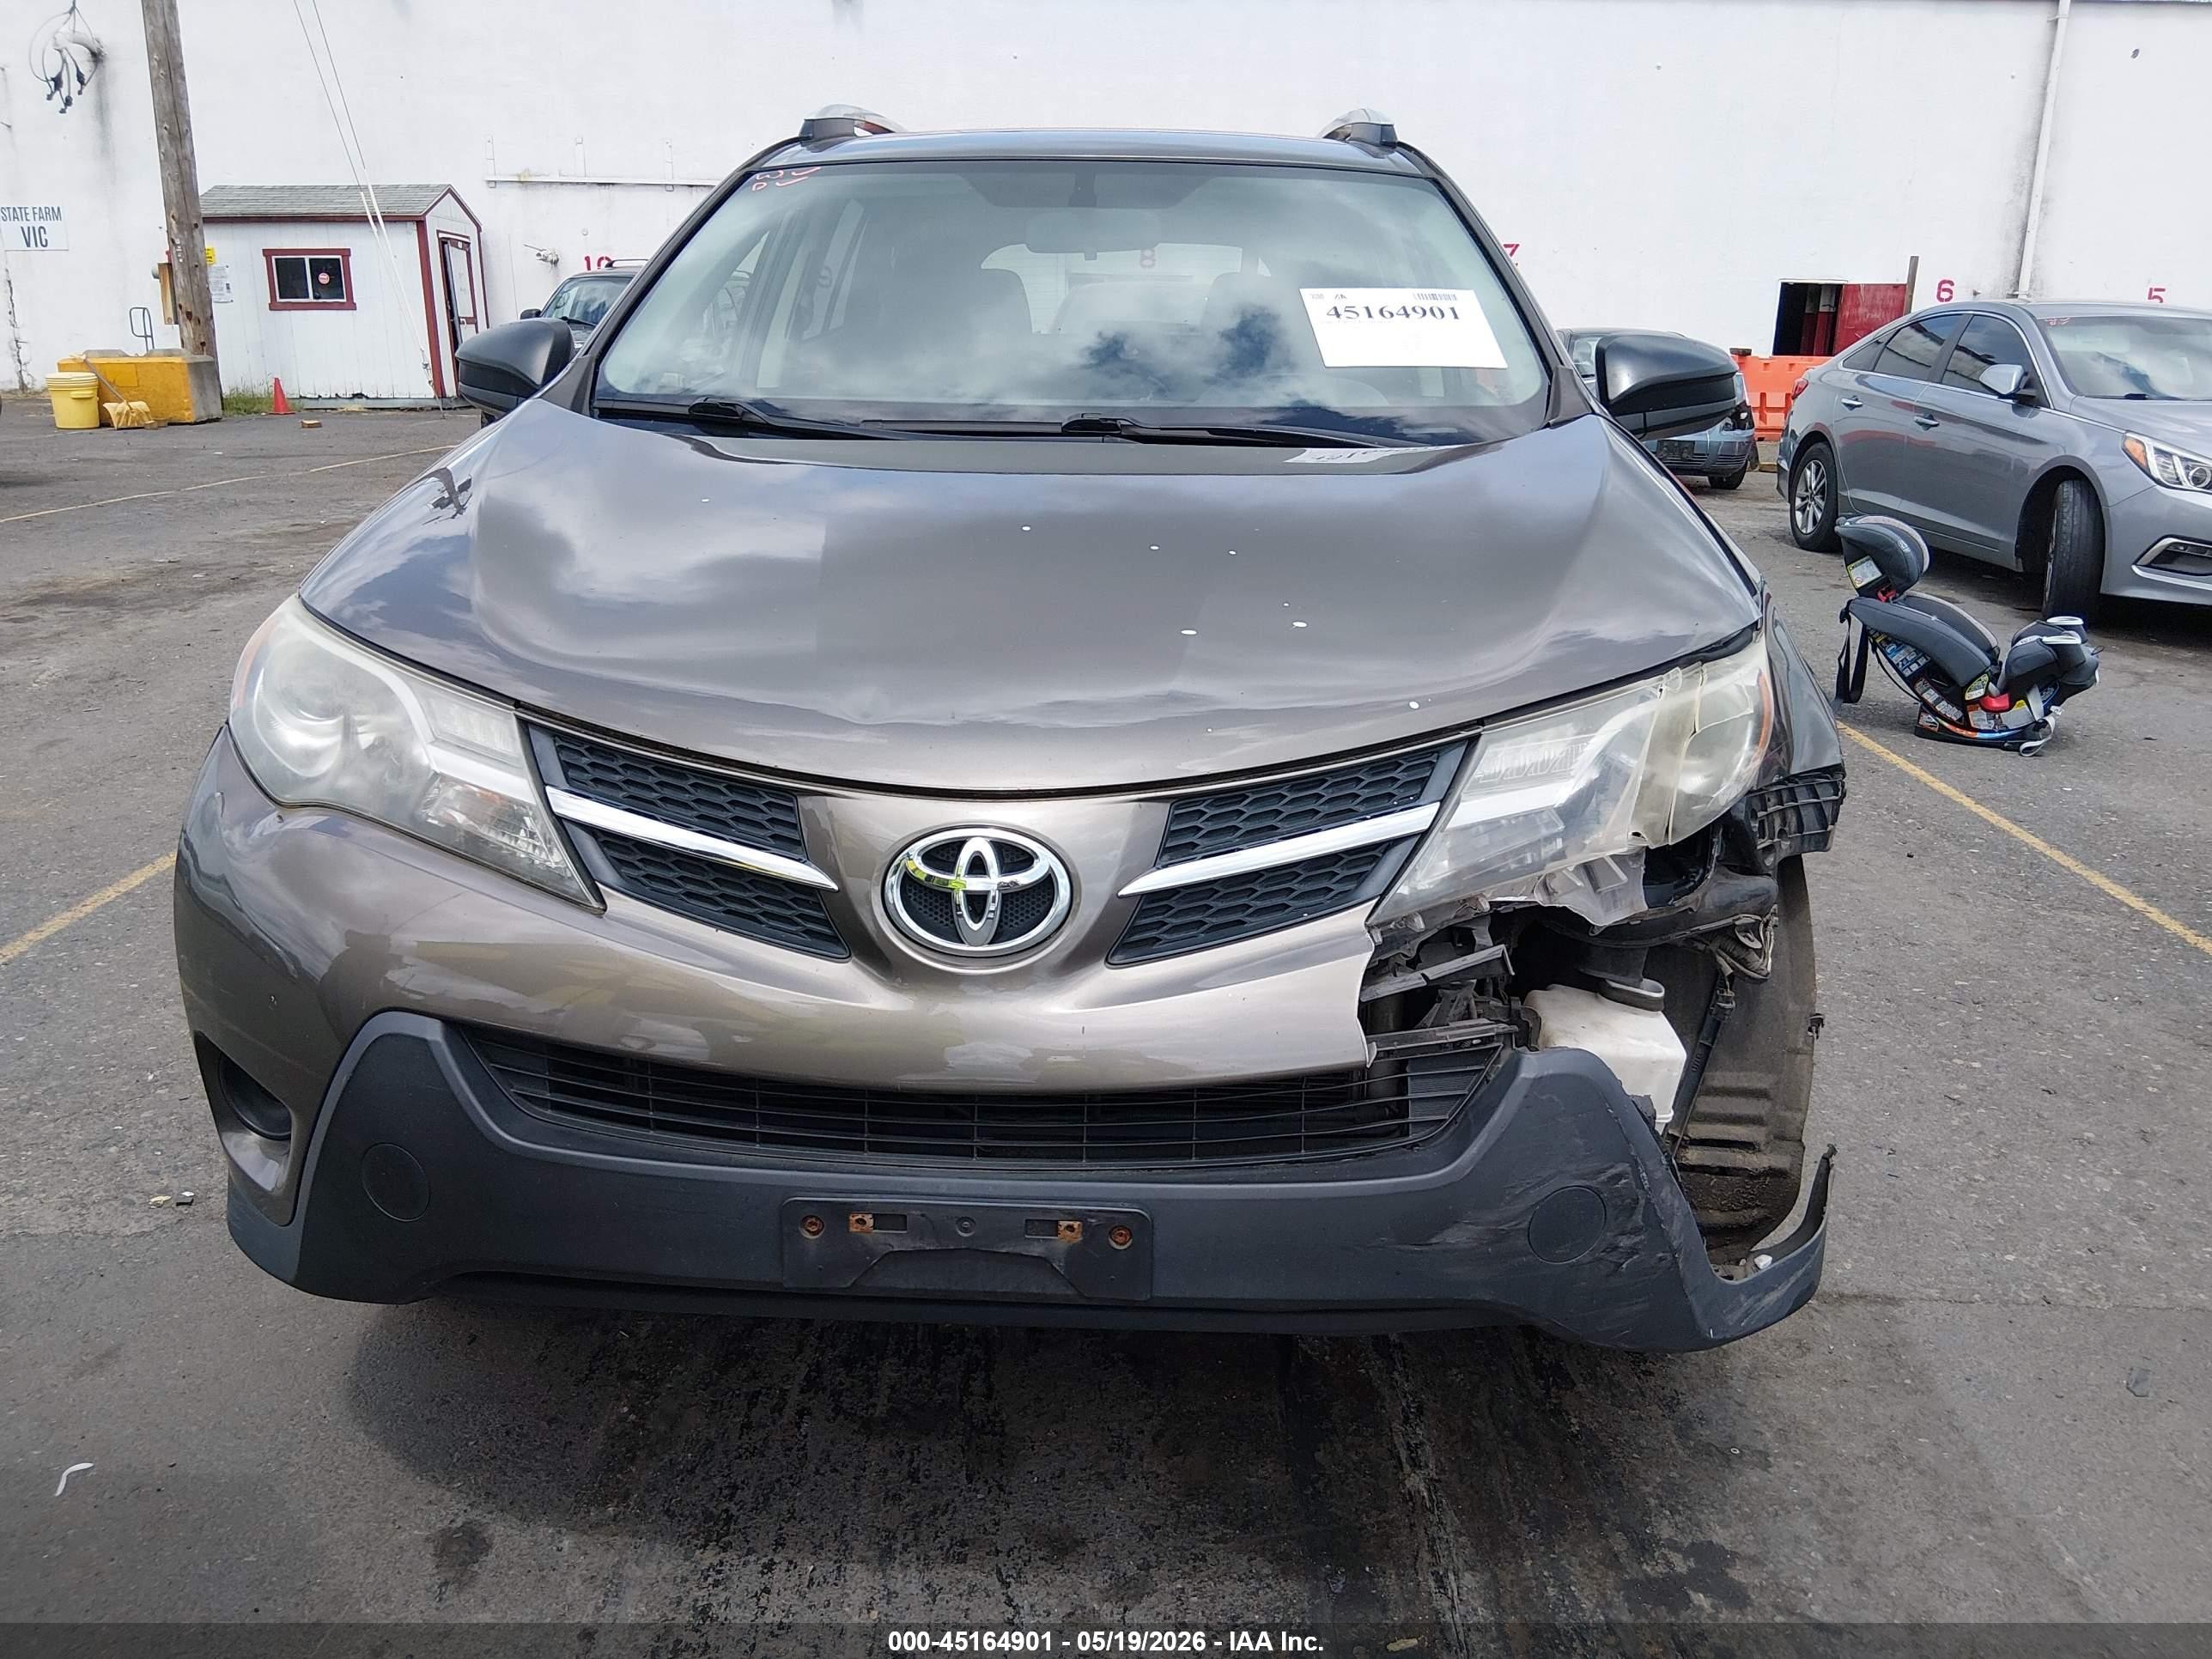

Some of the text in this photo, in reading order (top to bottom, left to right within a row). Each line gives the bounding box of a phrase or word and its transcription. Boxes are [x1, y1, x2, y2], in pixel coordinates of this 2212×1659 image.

[0, 206, 63, 222] STATE FARM
[20, 225, 49, 248] VIC
[1503, 243, 1520, 258] 7
[1936, 279, 1955, 303] 6
[2148, 287, 2166, 304] 5
[1326, 305, 1460, 320] 45164901
